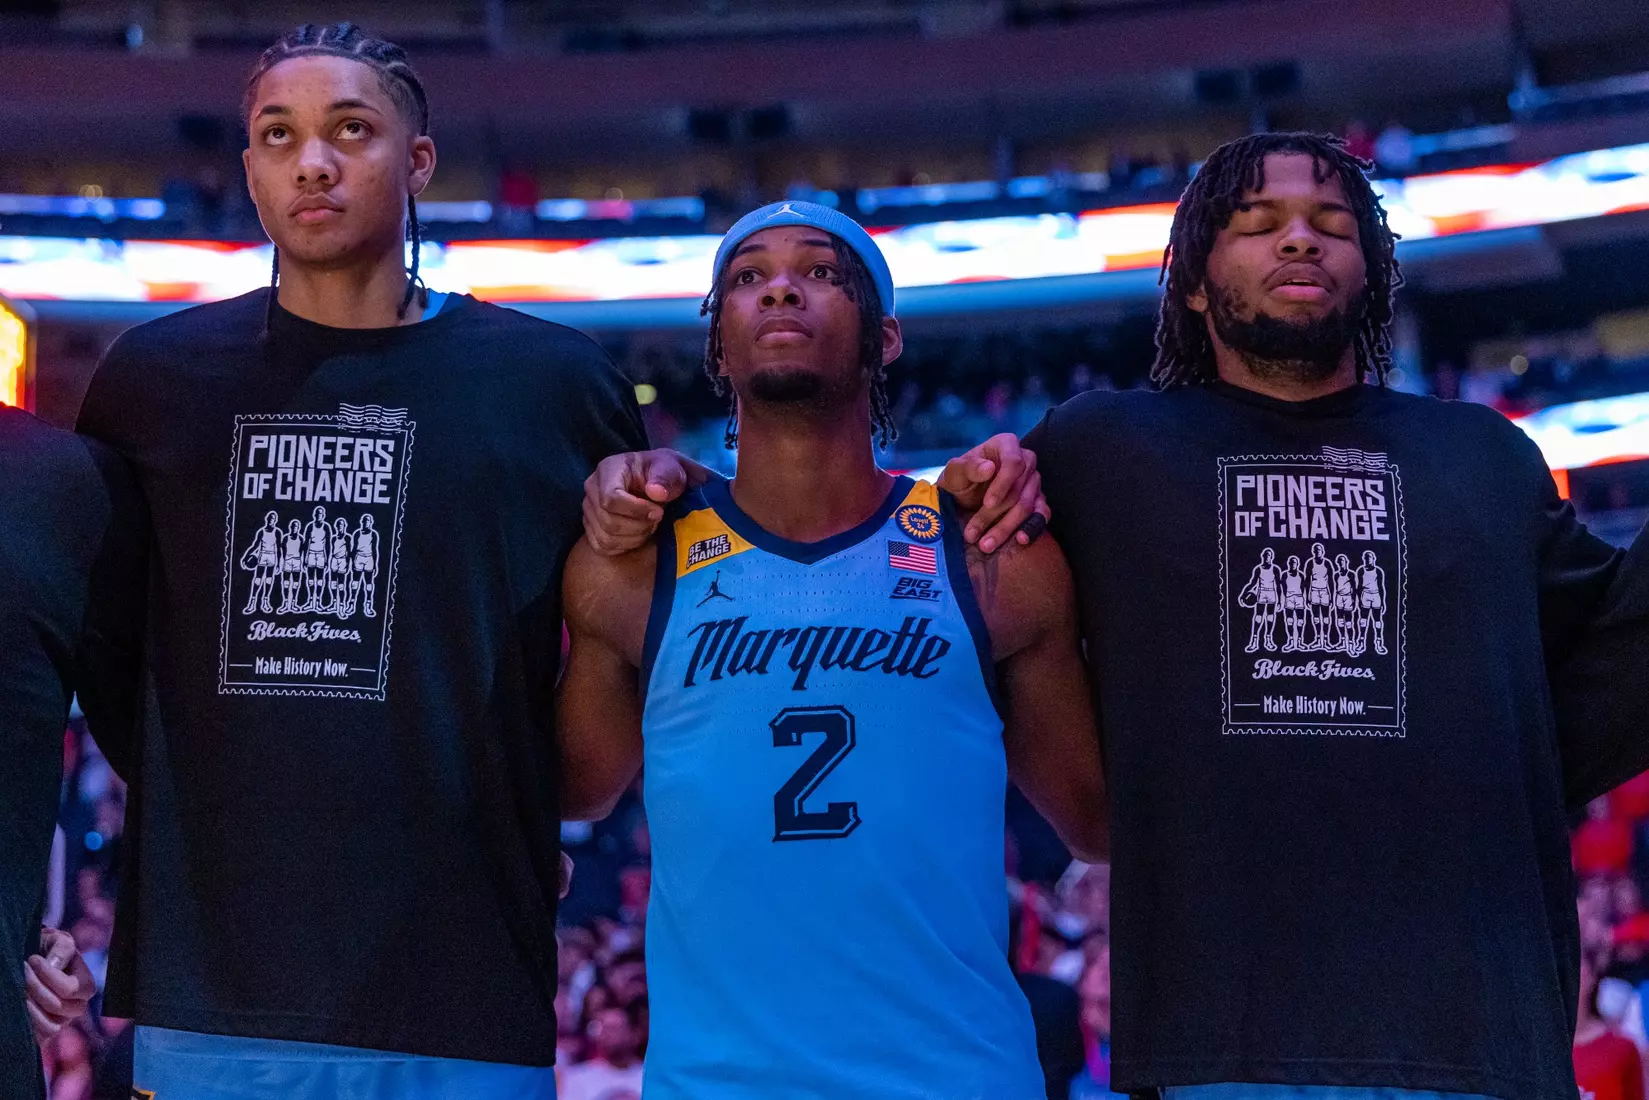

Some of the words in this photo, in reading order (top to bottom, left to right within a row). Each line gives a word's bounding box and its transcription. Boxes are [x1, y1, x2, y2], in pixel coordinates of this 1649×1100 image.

[247, 435, 395, 473] PIONEERS
[243, 472, 273, 499] OF
[275, 467, 393, 504] CHANGE
[1236, 475, 1385, 511] PIONEERS
[1234, 511, 1265, 537] OF
[1268, 506, 1390, 541] CHANGE
[689, 542, 702, 557] BE
[704, 535, 727, 550] THE
[892, 585, 943, 599] EAST
[898, 576, 934, 589] BIG
[247, 620, 309, 641] Black
[683, 615, 952, 691] Marquette
[255, 656, 282, 675] Make
[284, 656, 322, 678] History
[323, 658, 348, 677] Now.
[1252, 658, 1320, 680] Black
[1263, 695, 1294, 714] Make
[1296, 695, 1337, 717] History
[1340, 696, 1366, 716] Now.
[768, 705, 862, 843] 2
